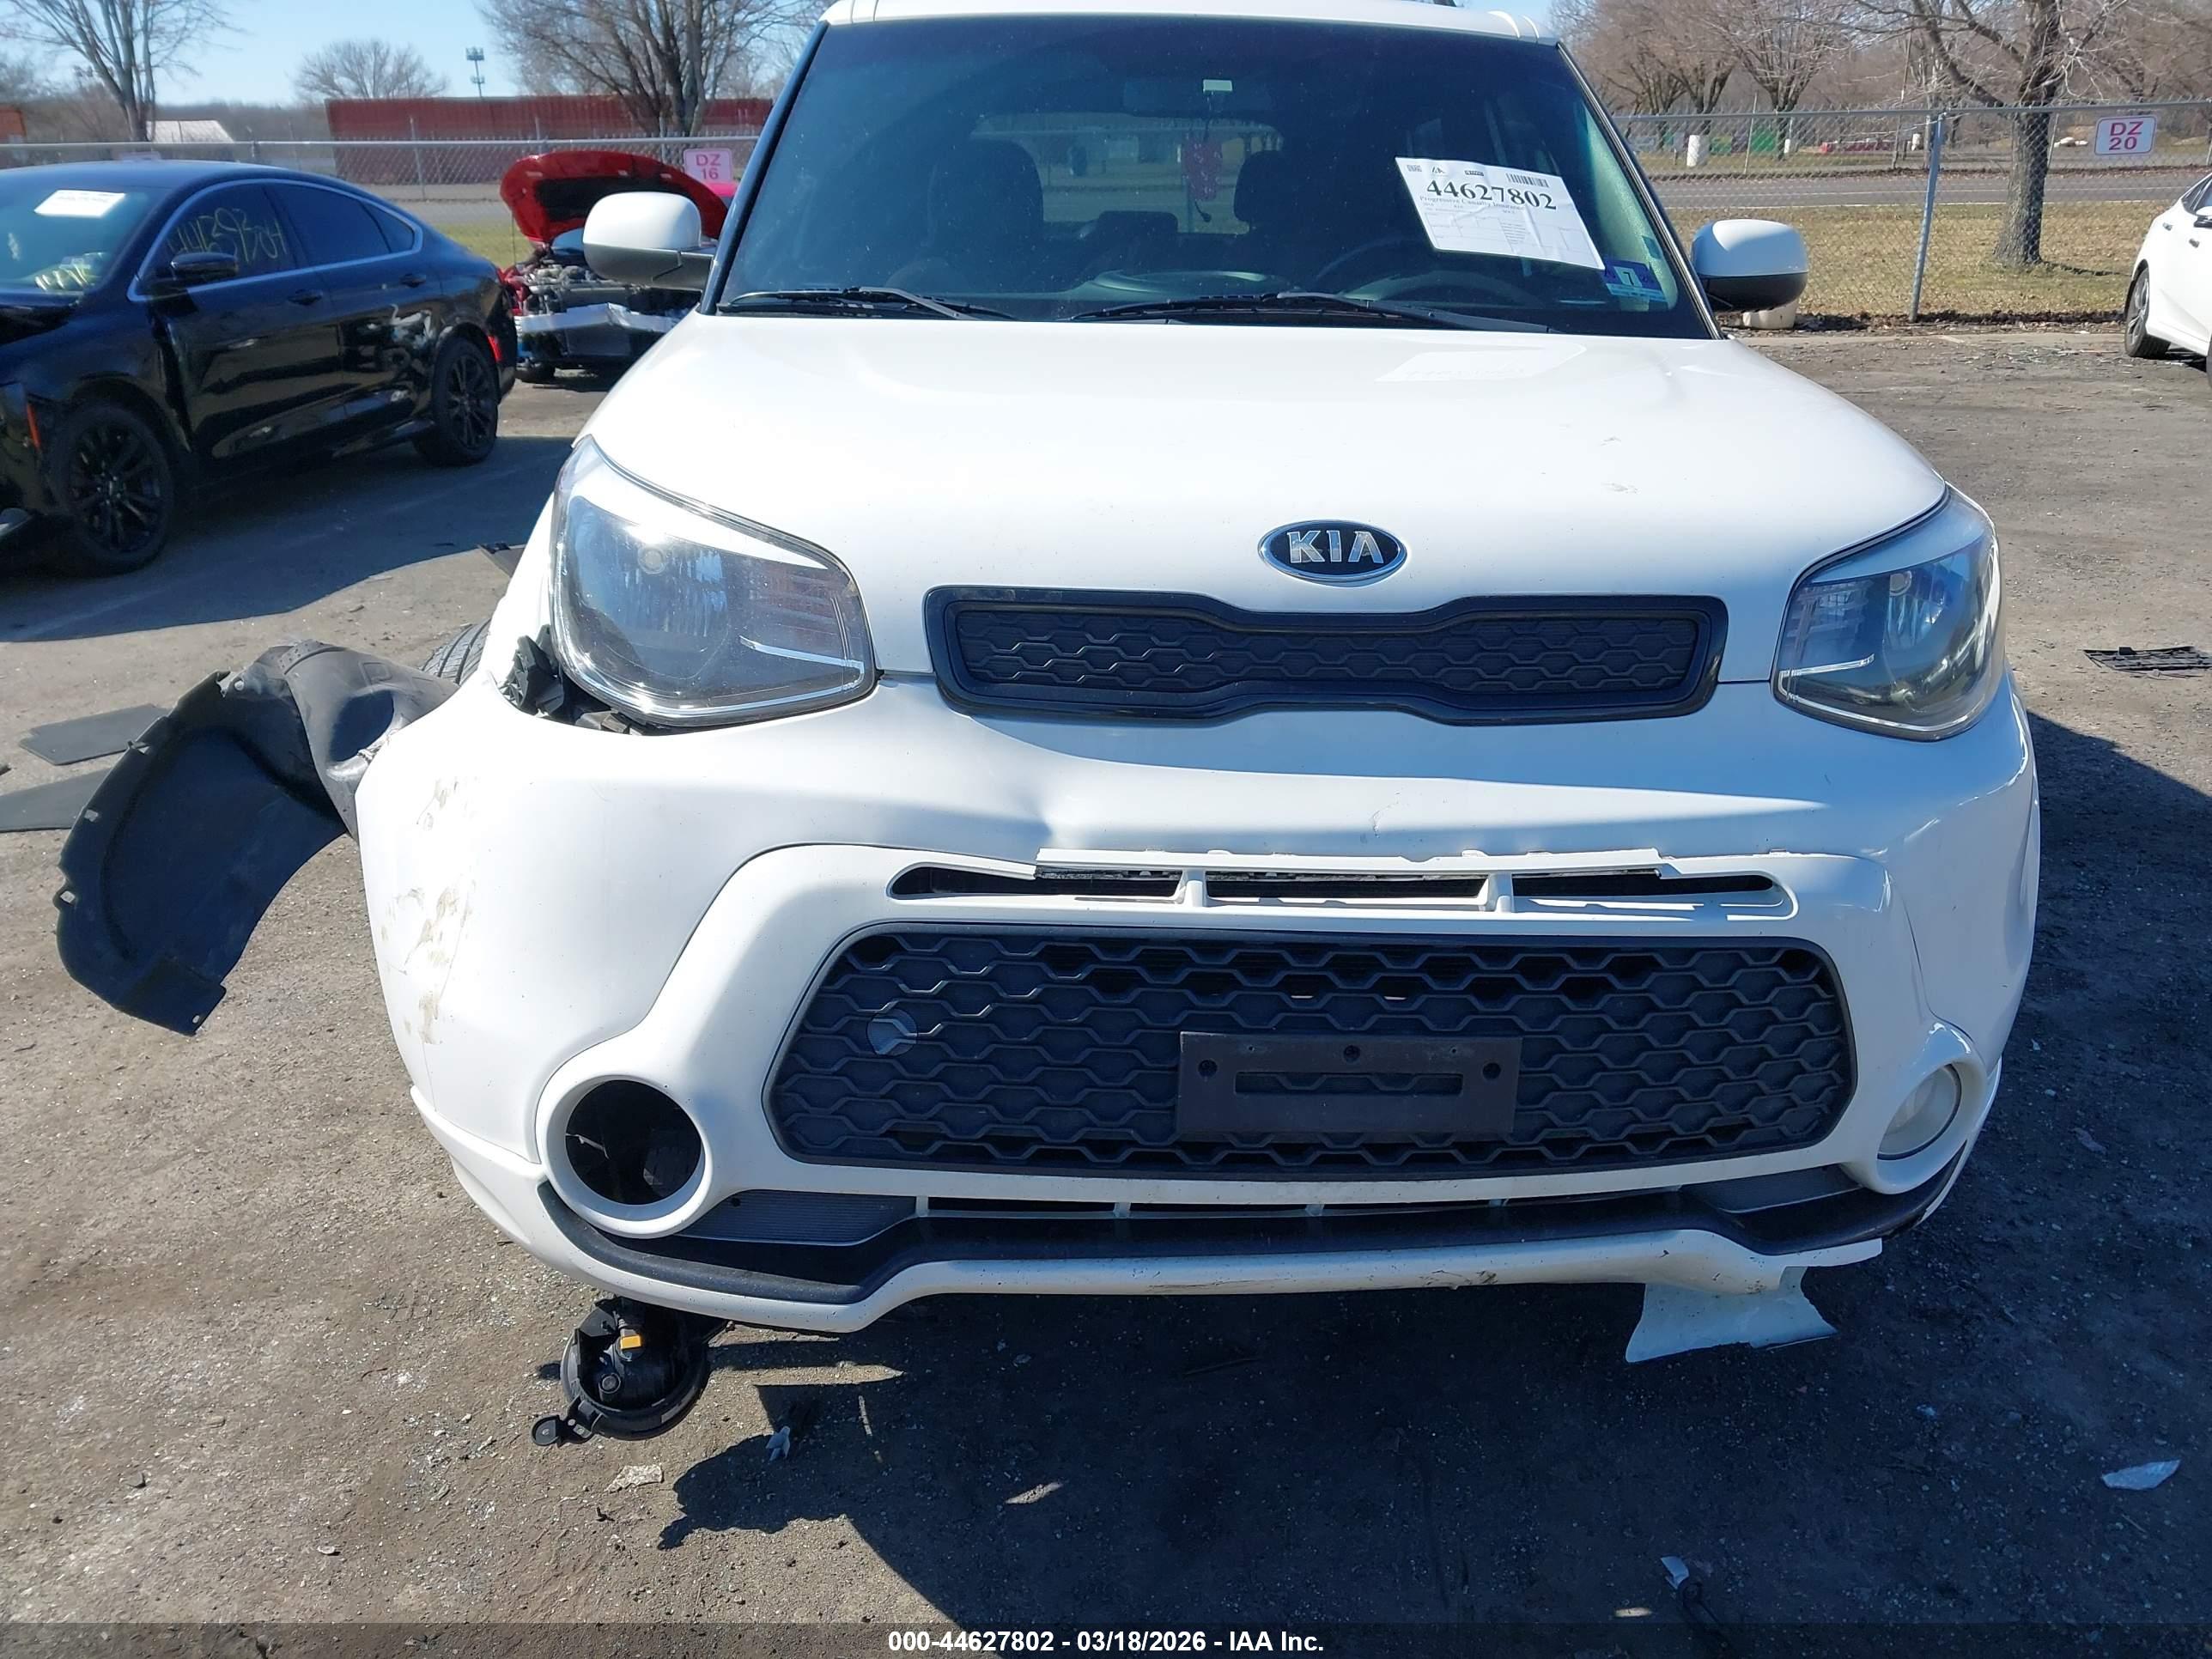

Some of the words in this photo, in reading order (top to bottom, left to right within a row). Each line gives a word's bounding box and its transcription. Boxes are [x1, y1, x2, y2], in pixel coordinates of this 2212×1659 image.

[2110, 121, 2143, 136] DZ
[2109, 137, 2137, 150] 20
[696, 154, 721, 166] DZ
[702, 167, 719, 179] 16
[1426, 179, 1557, 210] 44627802
[1622, 270, 1635, 286] 7
[1287, 530, 1384, 564] KIA
